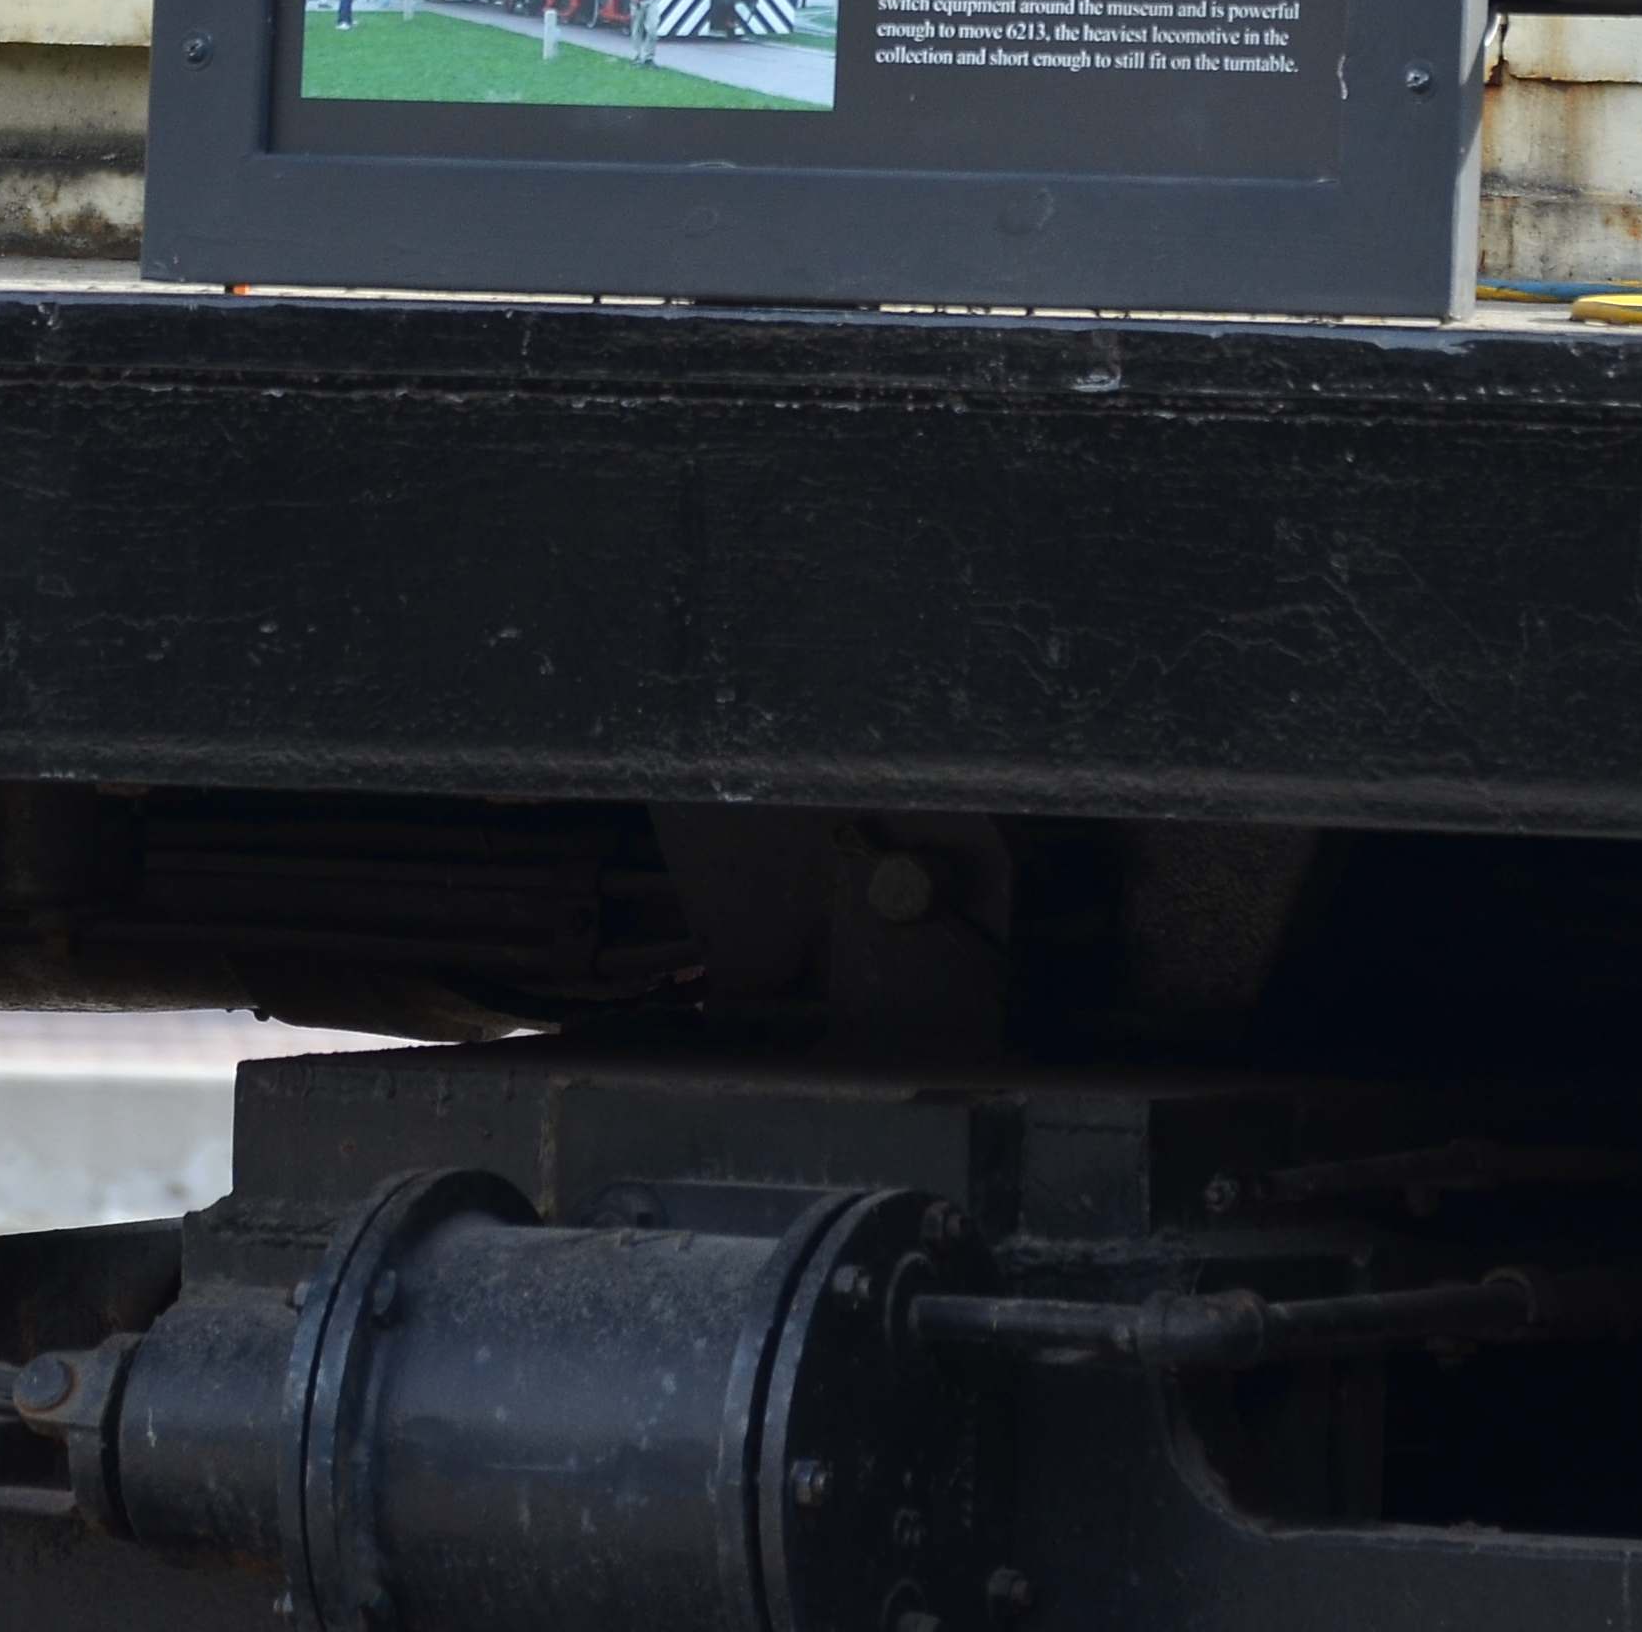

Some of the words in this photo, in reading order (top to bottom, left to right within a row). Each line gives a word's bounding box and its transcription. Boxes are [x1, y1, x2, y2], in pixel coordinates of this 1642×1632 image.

[1105, 1, 1174, 17] museum
[1209, 0, 1225, 19] is
[1227, 0, 1301, 23] powerful
[875, 18, 936, 43] enough
[937, 22, 956, 39] to
[957, 25, 1005, 42] move
[1005, 20, 1052, 44] 6213,
[1053, 21, 1081, 42] the
[1081, 22, 1148, 43] heaviest
[1151, 24, 1241, 46] locomotive
[1243, 27, 1261, 46] in
[1262, 26, 1290, 47] the
[874, 44, 954, 65] collection
[955, 46, 987, 66] and
[988, 46, 1030, 67] short
[1031, 48, 1092, 73] enough
[1093, 52, 1112, 69] to
[1113, 49, 1146, 70] still
[1148, 49, 1168, 70] fit
[1169, 55, 1192, 71] on
[1193, 51, 1221, 72] the
[1222, 53, 1299, 73] turntable.
